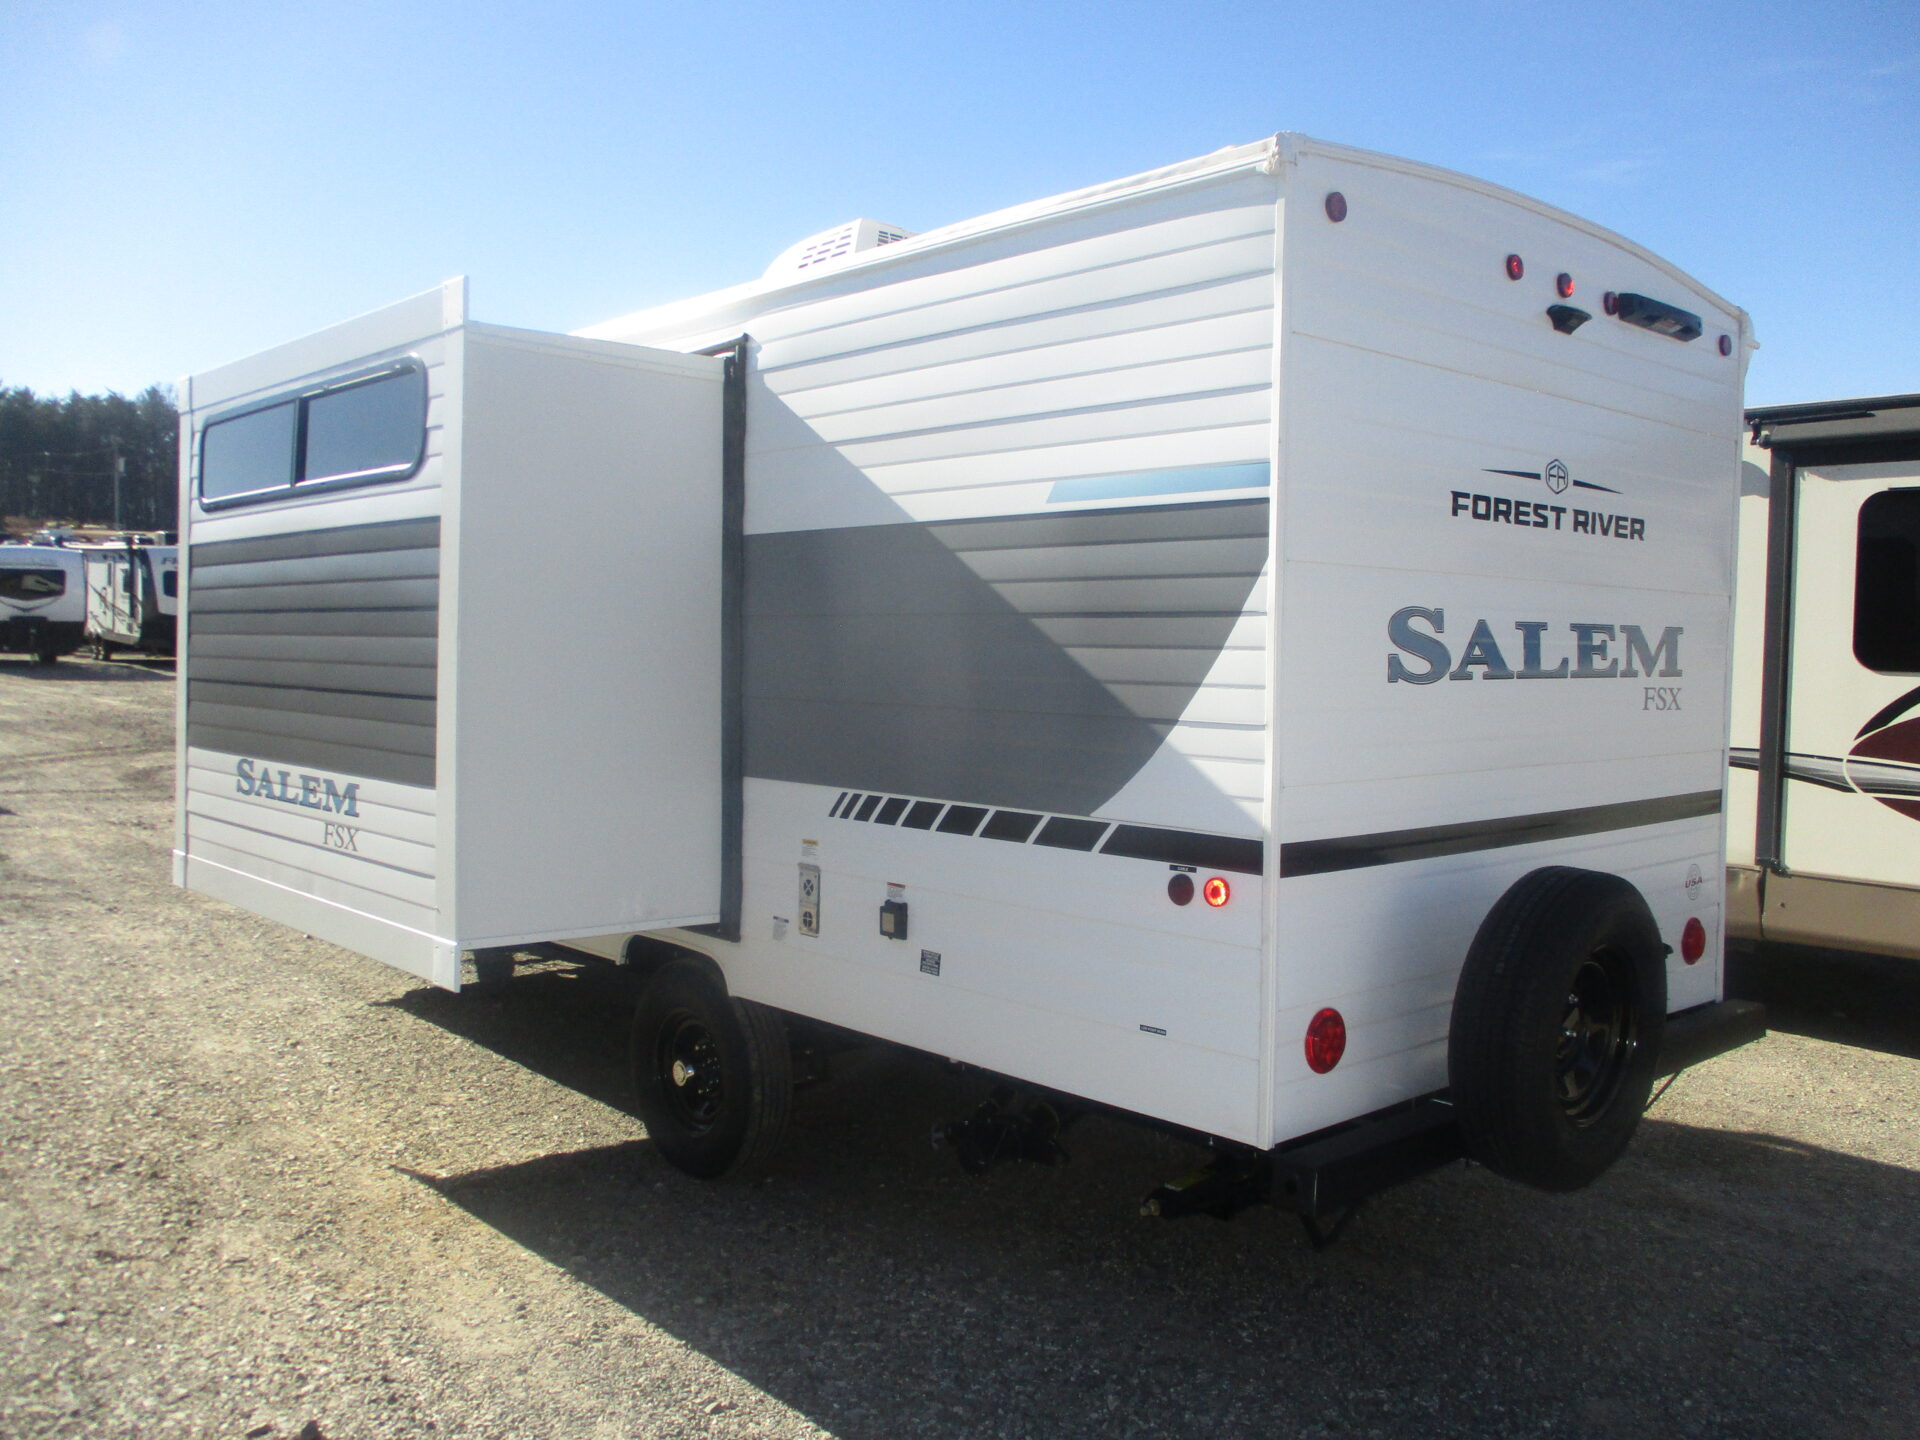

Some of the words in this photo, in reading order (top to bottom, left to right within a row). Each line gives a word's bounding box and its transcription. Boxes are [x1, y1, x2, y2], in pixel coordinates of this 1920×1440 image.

[1451, 490, 1567, 530] FOREST
[1573, 509, 1645, 541] RIVER
[1387, 606, 1684, 685] SALEM
[1642, 687, 1682, 711] FSX
[237, 758, 360, 817] SALEM
[323, 823, 360, 851] FSX
[1684, 876, 1703, 889] USA
